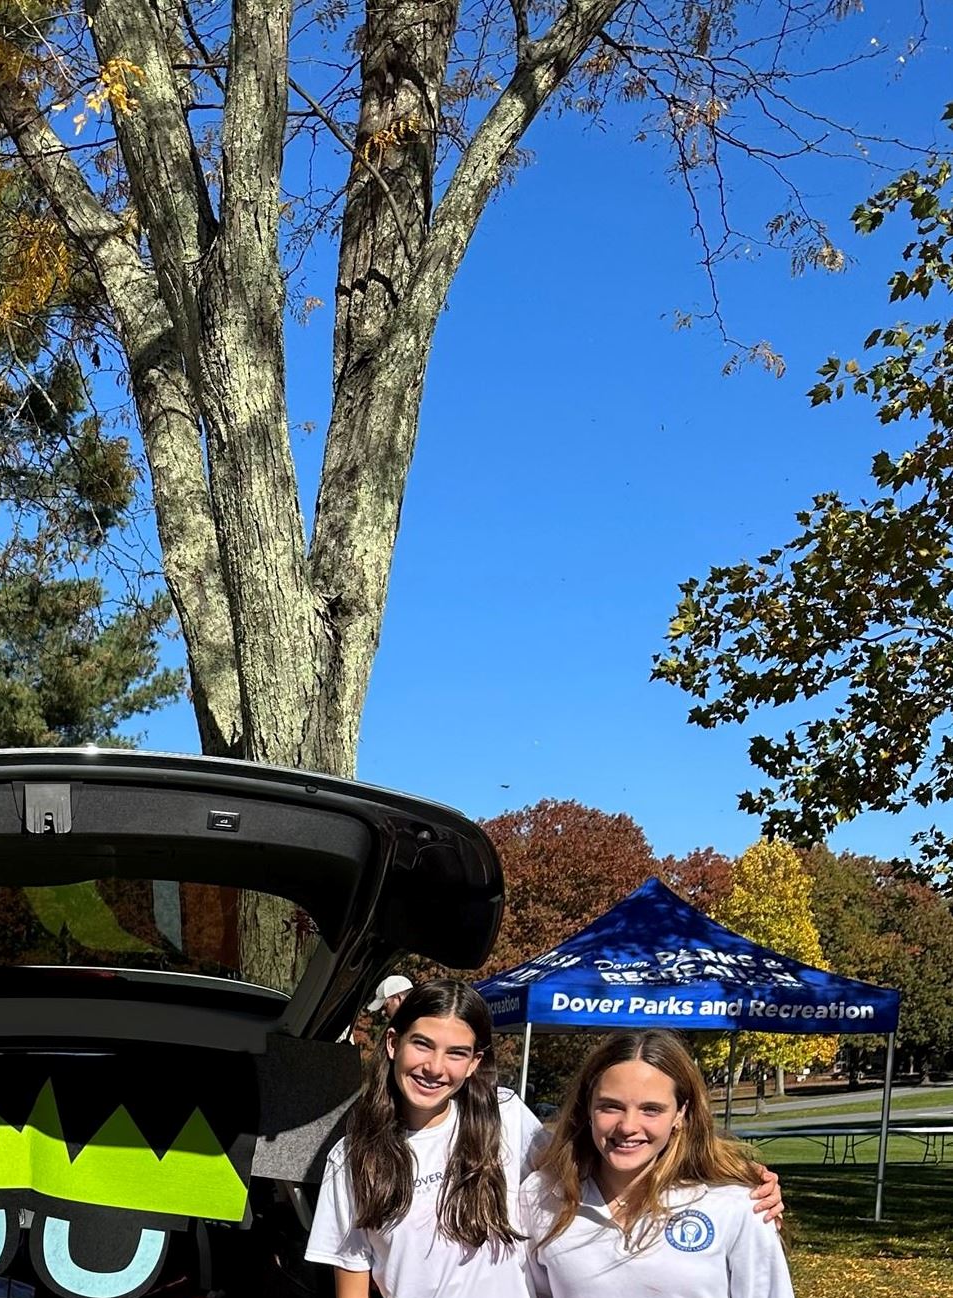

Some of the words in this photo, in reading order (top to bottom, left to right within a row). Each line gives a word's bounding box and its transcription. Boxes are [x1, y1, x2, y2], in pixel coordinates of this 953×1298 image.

[594, 958, 650, 971] Dover
[552, 992, 624, 1014] Dover
[628, 996, 693, 1015] Parks
[699, 998, 743, 1017] and
[748, 999, 875, 1020] Recreation
[413, 1172, 443, 1187] OVER
